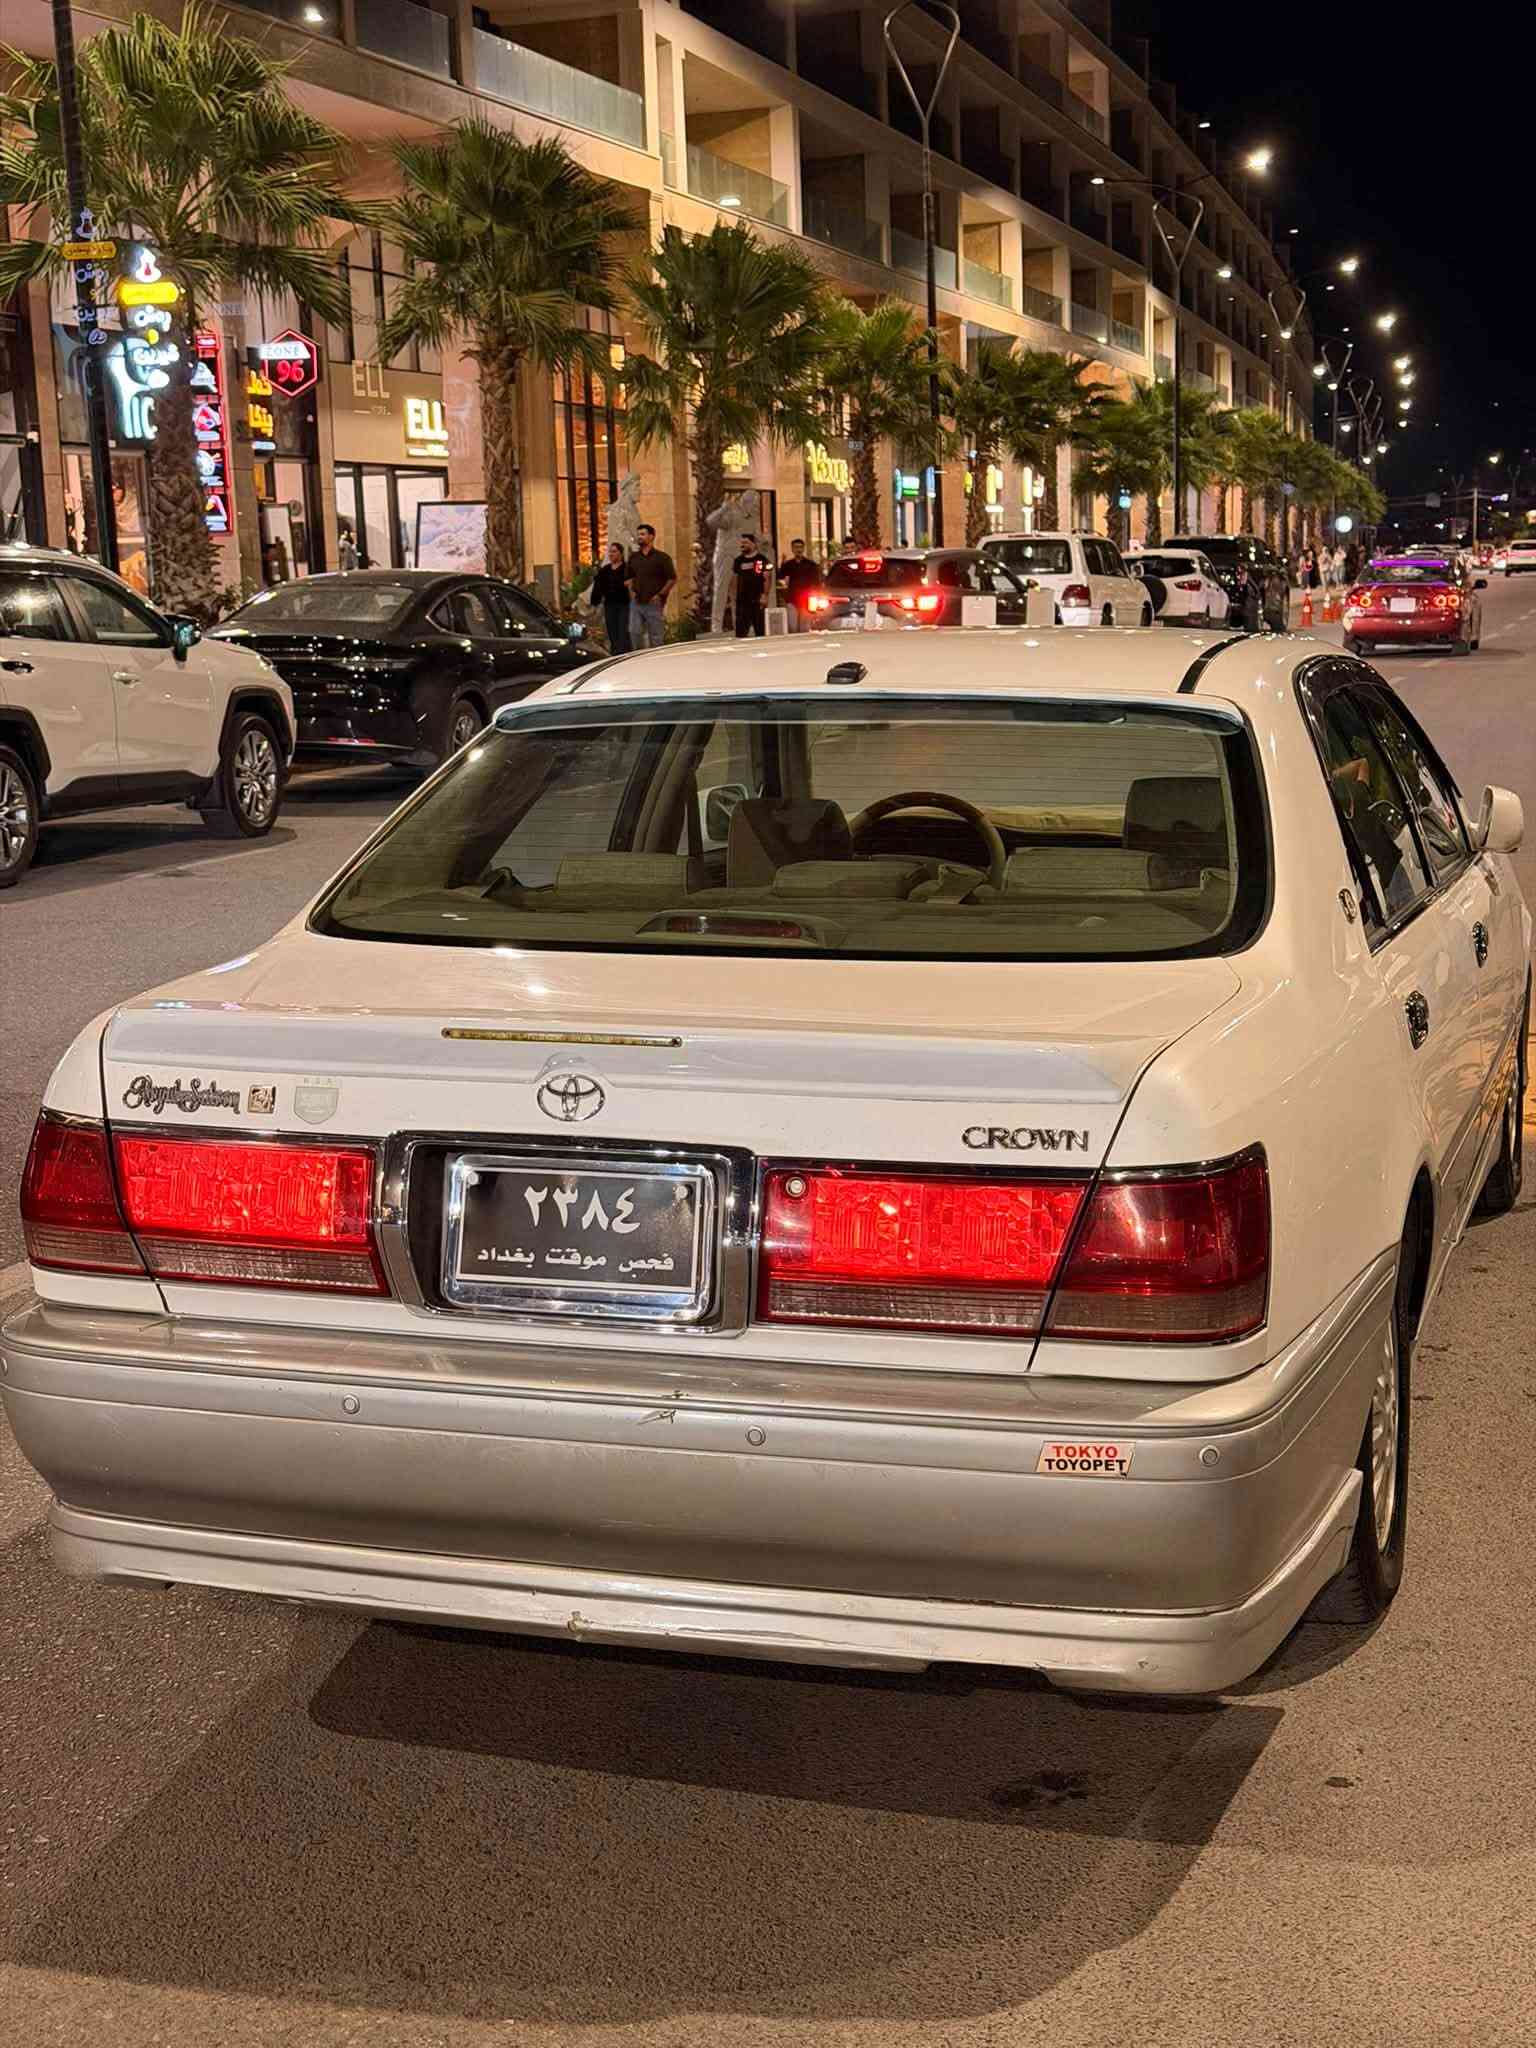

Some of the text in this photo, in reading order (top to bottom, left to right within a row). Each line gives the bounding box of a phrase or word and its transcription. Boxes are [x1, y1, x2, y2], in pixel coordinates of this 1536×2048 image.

[264, 346, 300, 357] ZONE
[277, 360, 304, 383] 96
[122, 1074, 183, 1115] Royal
[178, 1078, 241, 1115] Saloon
[961, 1126, 1089, 1152] CROWN
[523, 1184, 641, 1234] ٢٣٨٤
[477, 1246, 675, 1279] فحص موقت بغداد
[1052, 1445, 1118, 1458] TOKYO
[1044, 1458, 1127, 1472] TOYOPET
